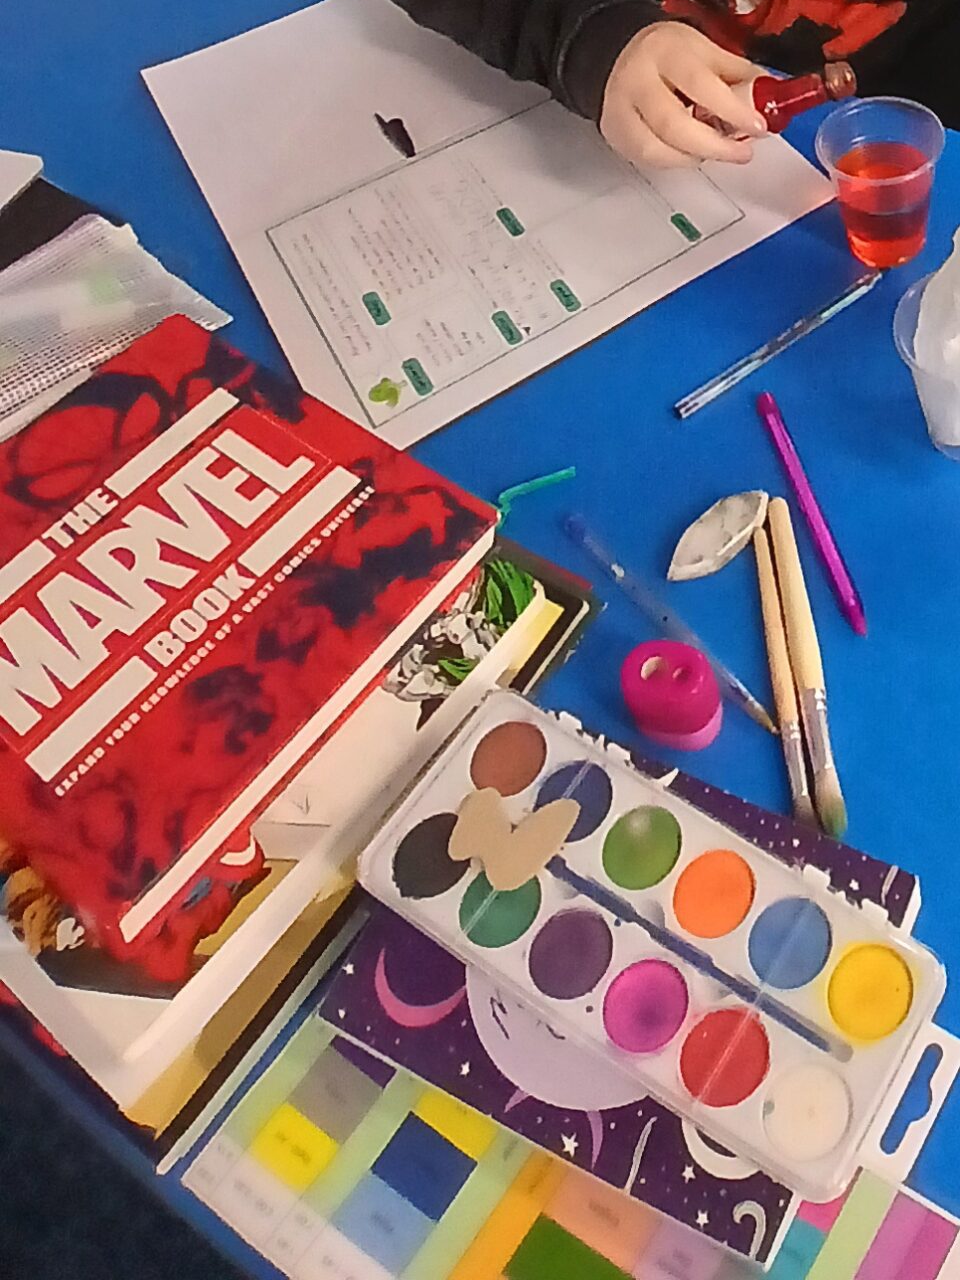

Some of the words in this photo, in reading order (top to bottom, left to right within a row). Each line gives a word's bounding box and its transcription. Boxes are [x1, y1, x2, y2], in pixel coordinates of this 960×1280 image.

[0, 428, 316, 734] MARVEL
[41, 487, 118, 548] THE
[143, 563, 256, 667] BOOK
[55, 746, 105, 797] EXPAND
[105, 712, 141, 746] YOUR
[140, 639, 216, 712] KNOWLEDGE
[215, 623, 232, 640] OF
[232, 613, 244, 625] A
[242, 582, 275, 613] VAST
[274, 537, 322, 583] COMICS
[320, 485, 376, 538] UNIVERSE
